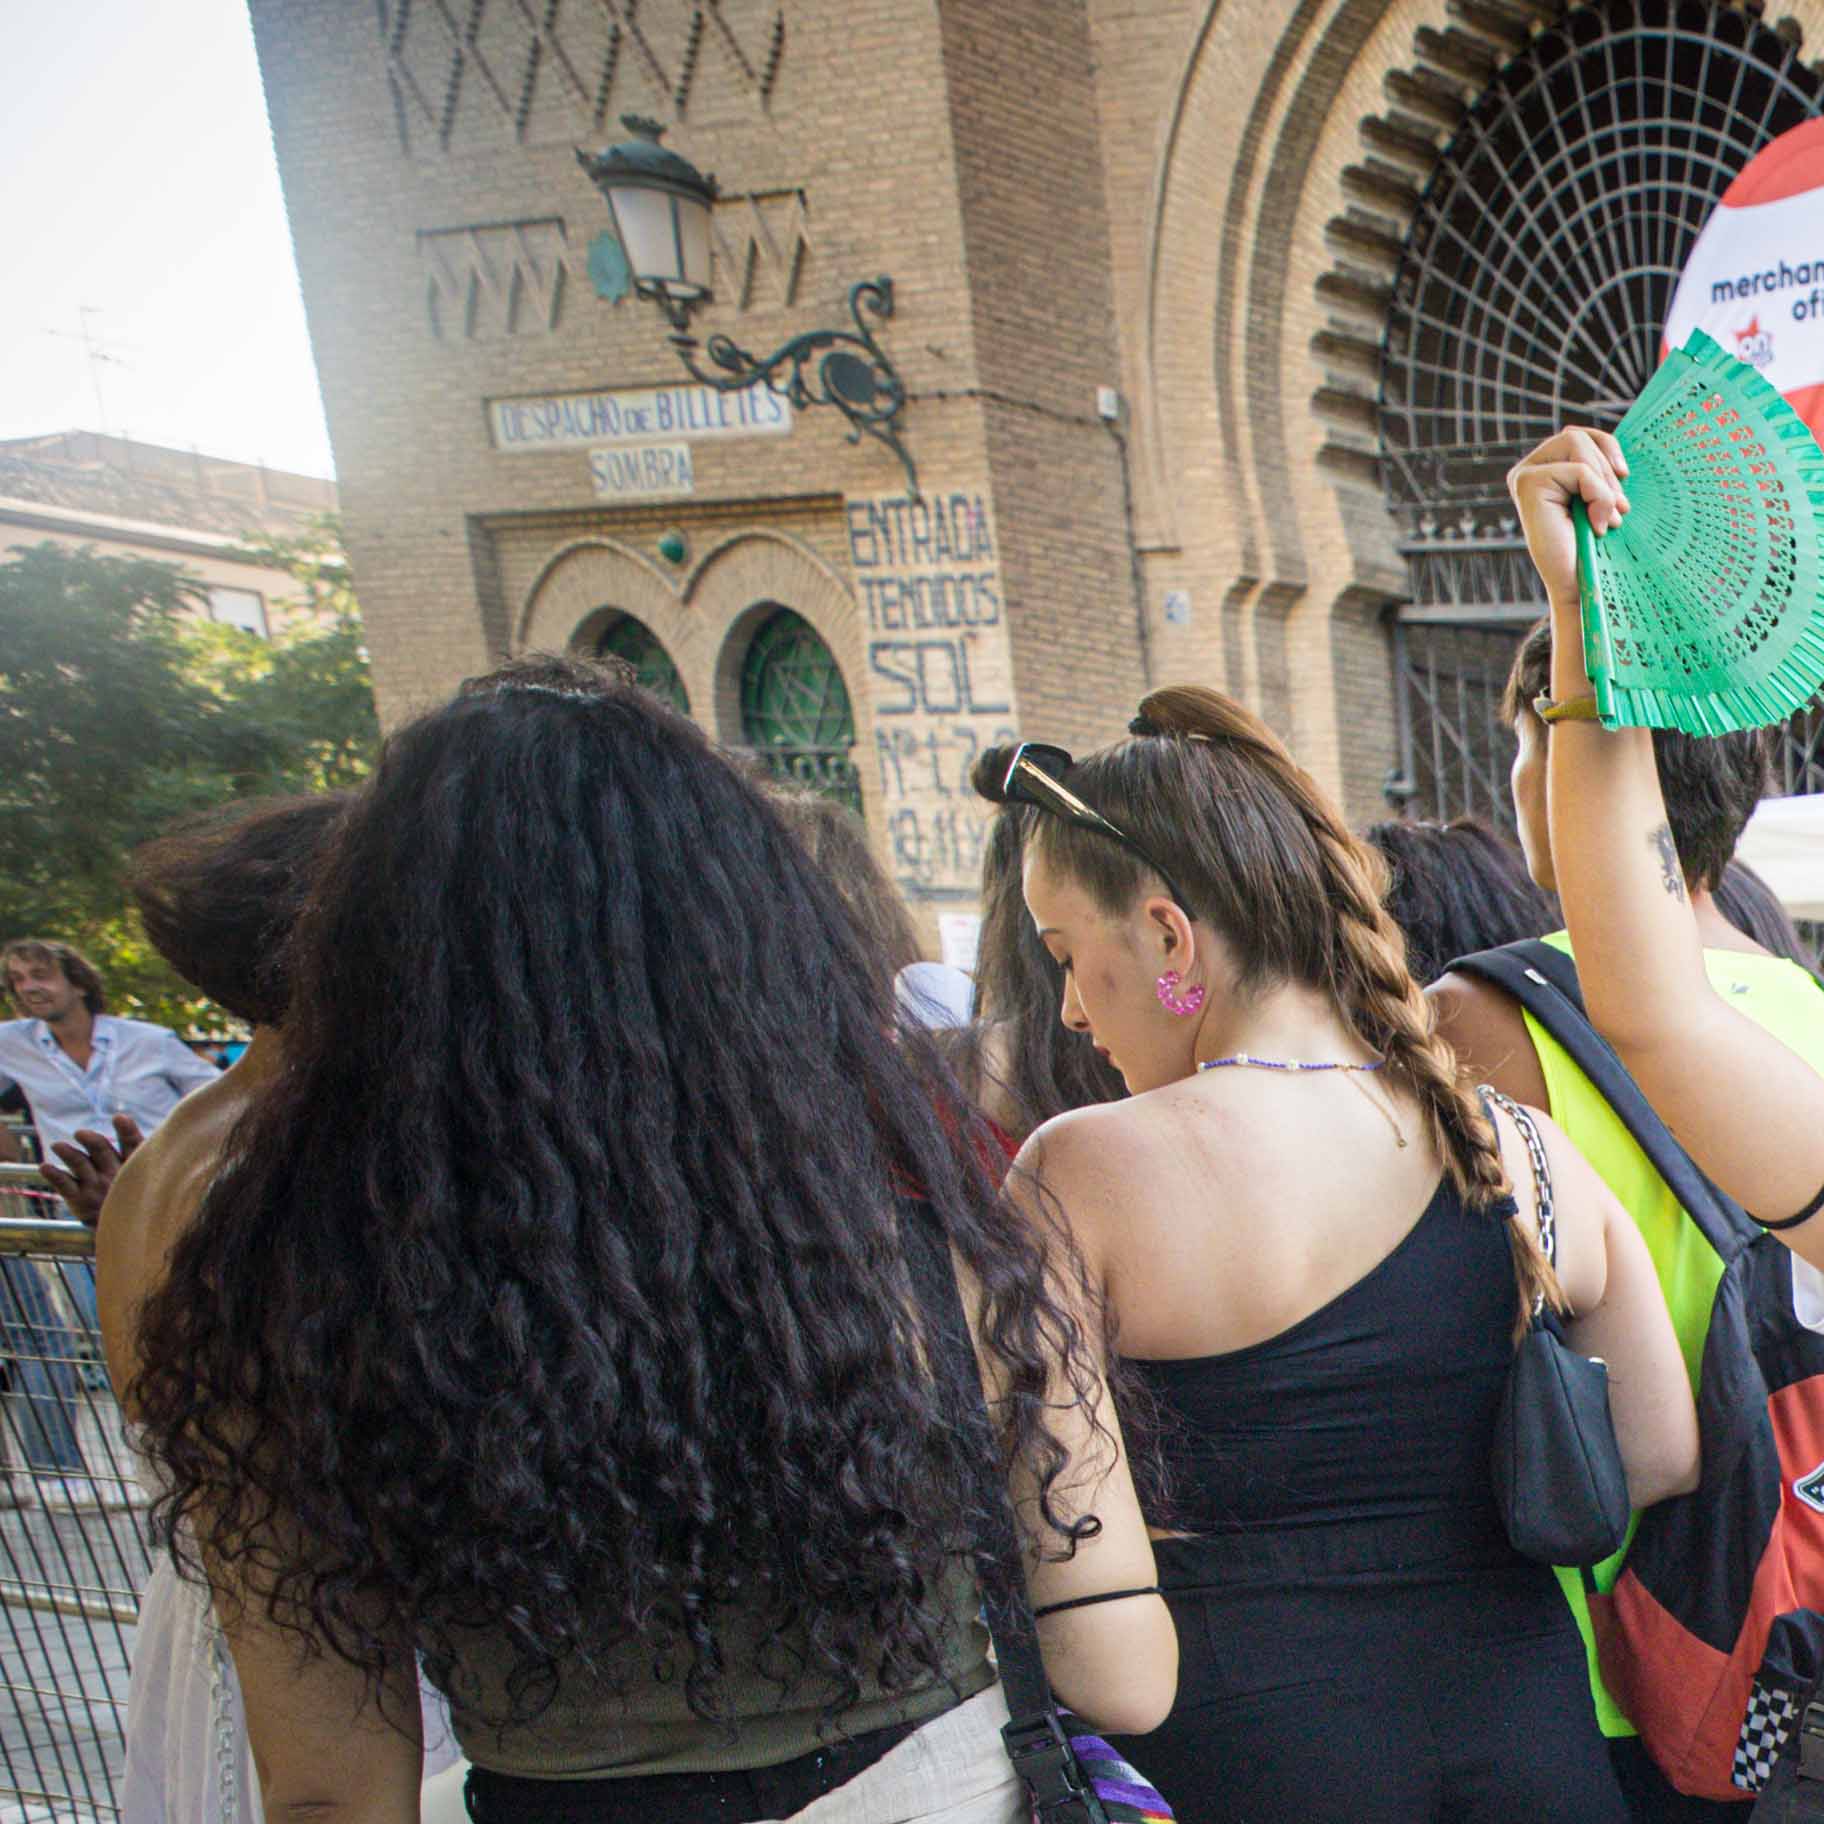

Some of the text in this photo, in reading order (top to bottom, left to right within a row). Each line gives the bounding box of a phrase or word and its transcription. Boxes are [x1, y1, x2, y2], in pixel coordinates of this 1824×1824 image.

[501, 395, 621, 442] DESPACHO
[591, 447, 692, 491] SOMBRA
[849, 494, 993, 566] ENTRADA
[859, 573, 998, 631] TENDIDOS
[869, 637, 1009, 714] SOL
